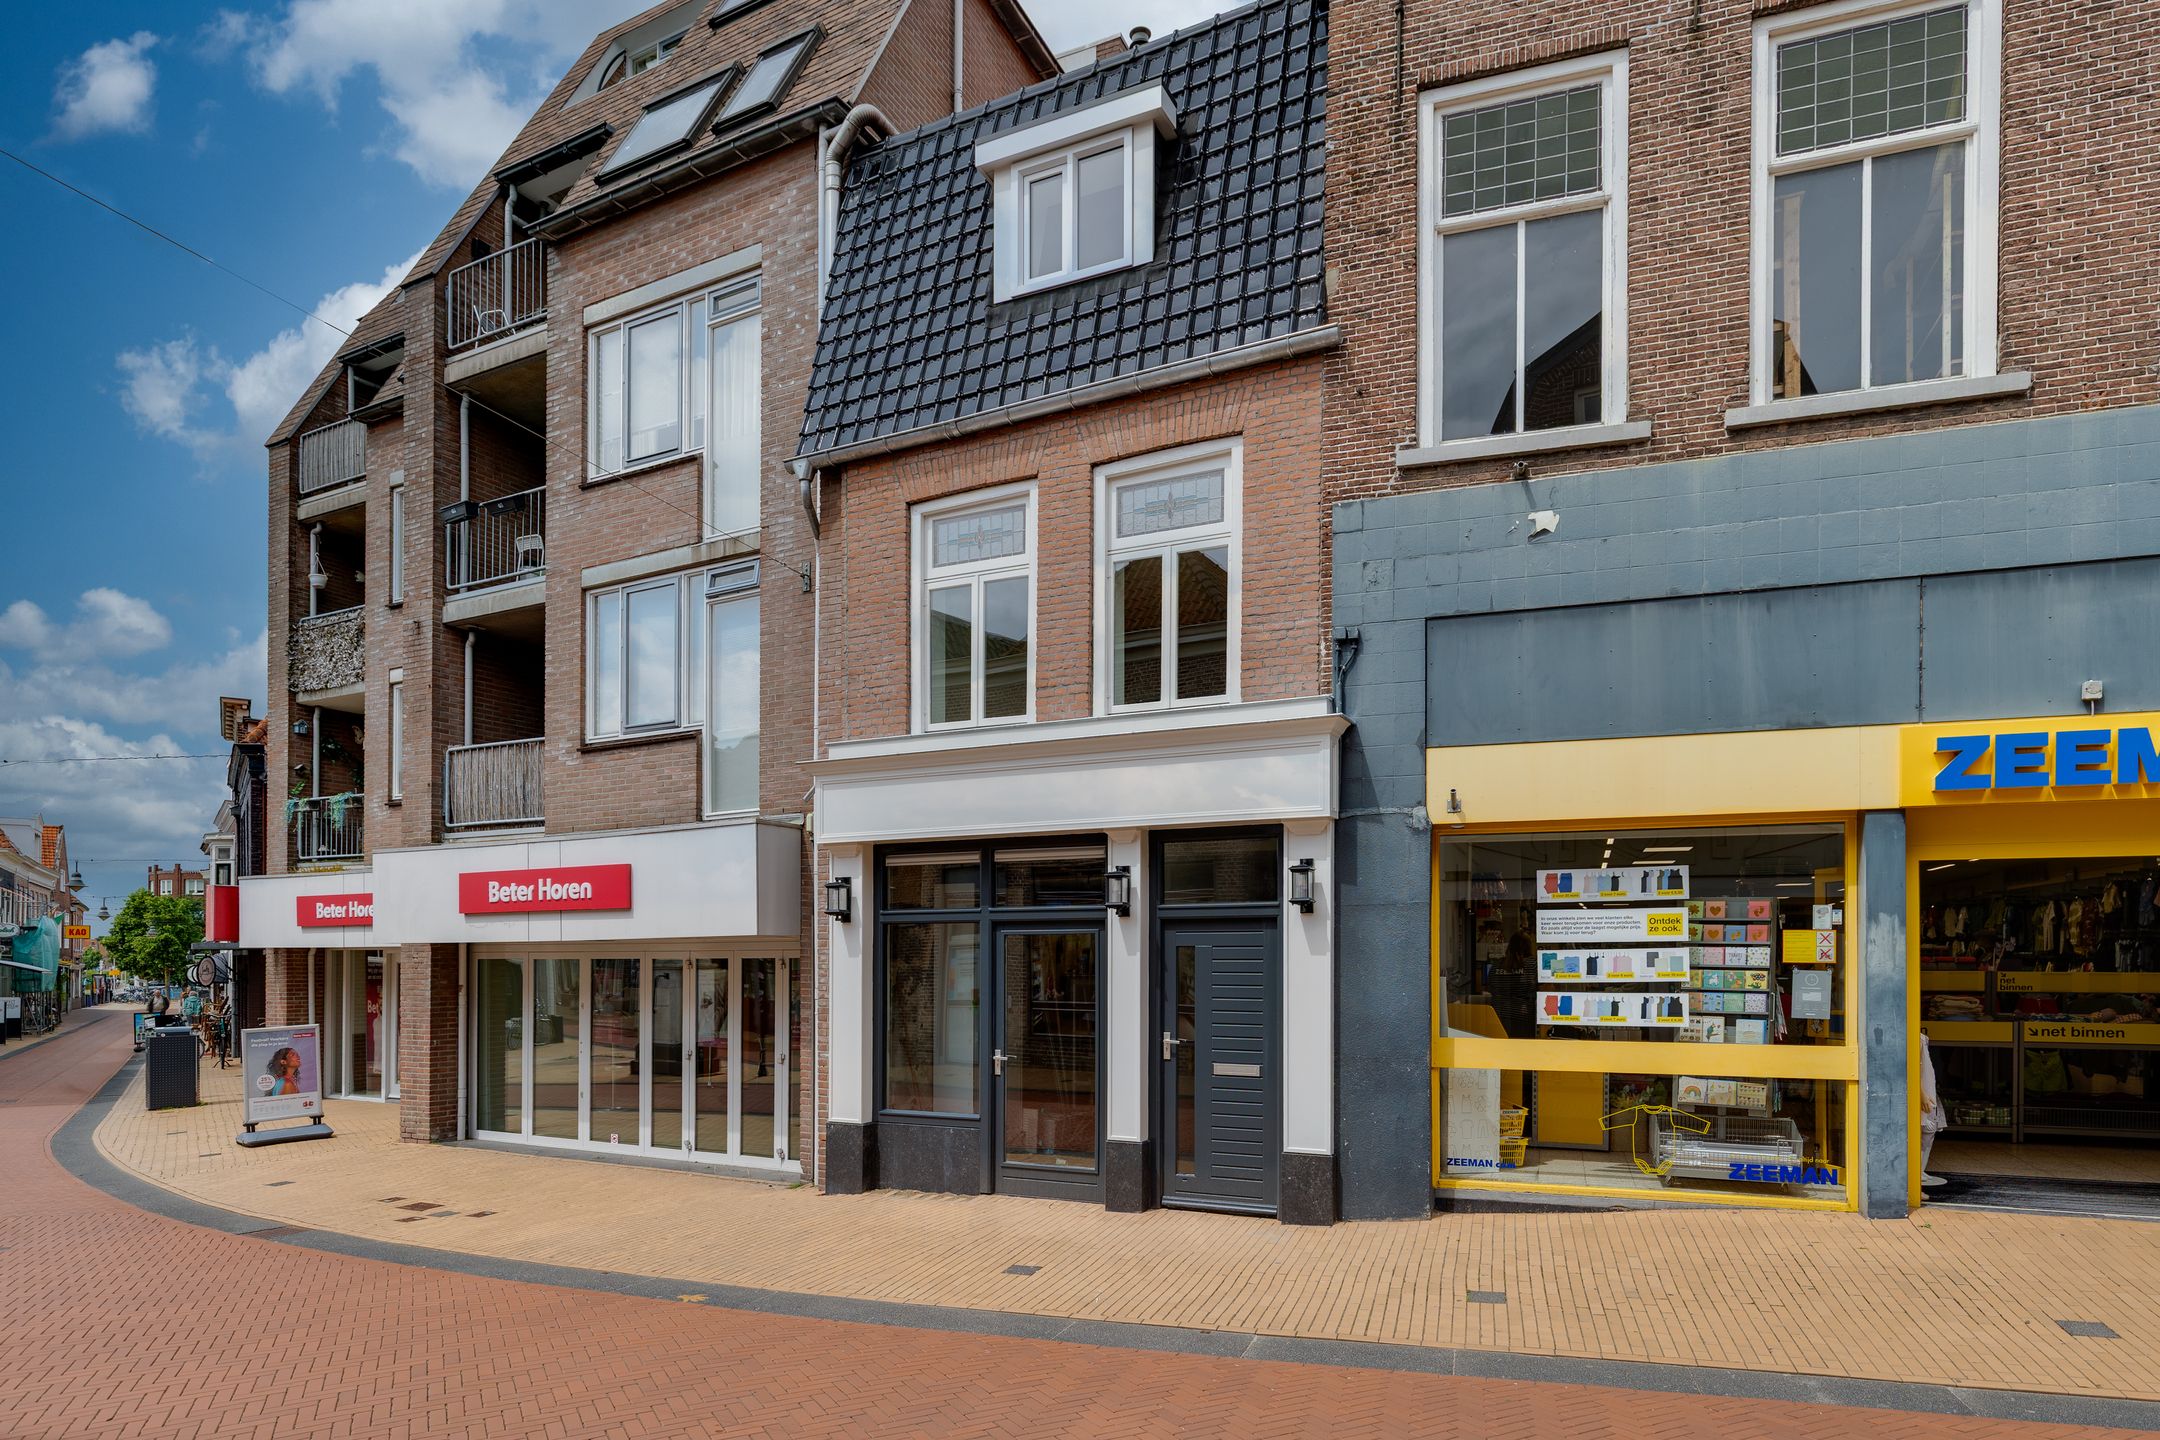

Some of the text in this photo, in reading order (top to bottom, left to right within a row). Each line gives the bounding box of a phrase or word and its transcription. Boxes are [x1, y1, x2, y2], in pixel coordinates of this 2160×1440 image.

[488, 878, 592, 903] Beter Horen
[316, 902, 347, 919] Beter
[1649, 917, 1681, 925] Ontdek
[2000, 983, 2033, 991] binnen
[2041, 1026, 2125, 1038] net binnen
[1728, 1162, 1838, 1186] ZEEMAN
